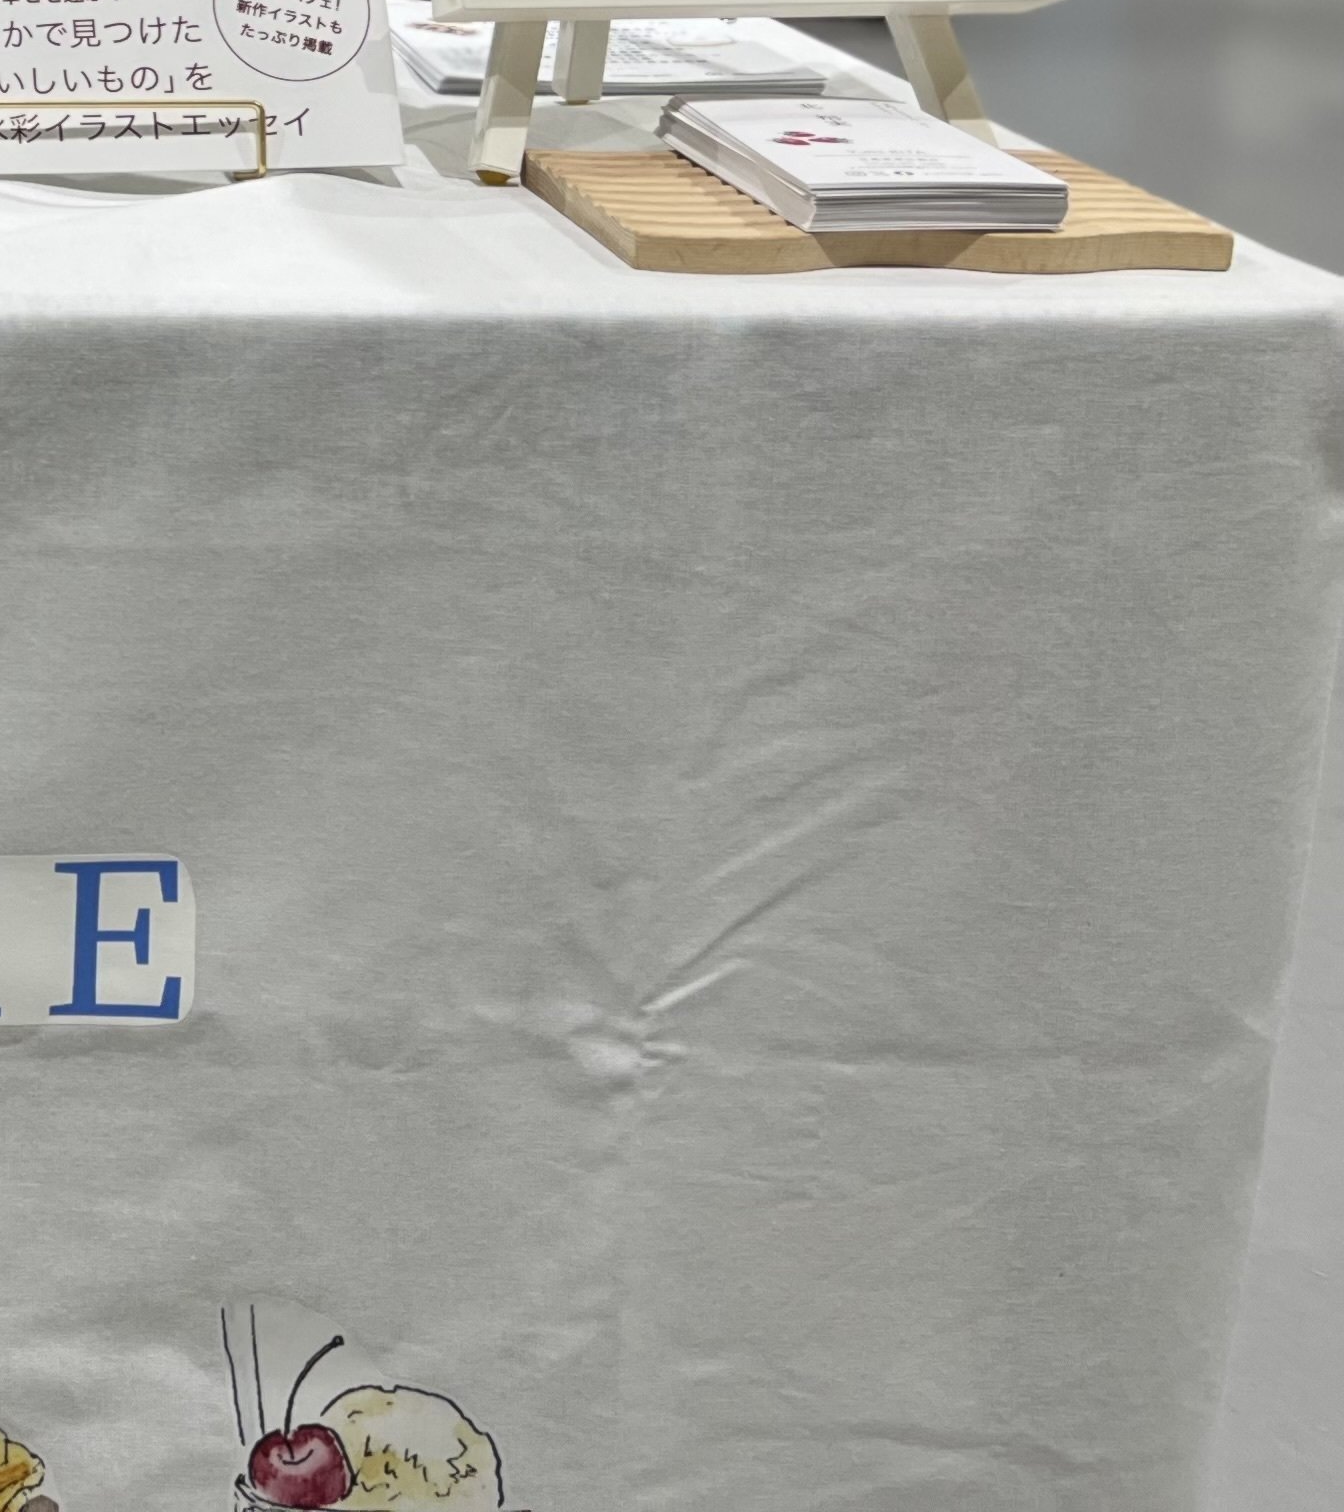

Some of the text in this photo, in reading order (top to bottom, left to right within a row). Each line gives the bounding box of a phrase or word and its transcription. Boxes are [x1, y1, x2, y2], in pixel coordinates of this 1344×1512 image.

[236, 0, 342, 34] 新作イラストも
[240, 24, 333, 55] たっぷり掲載
